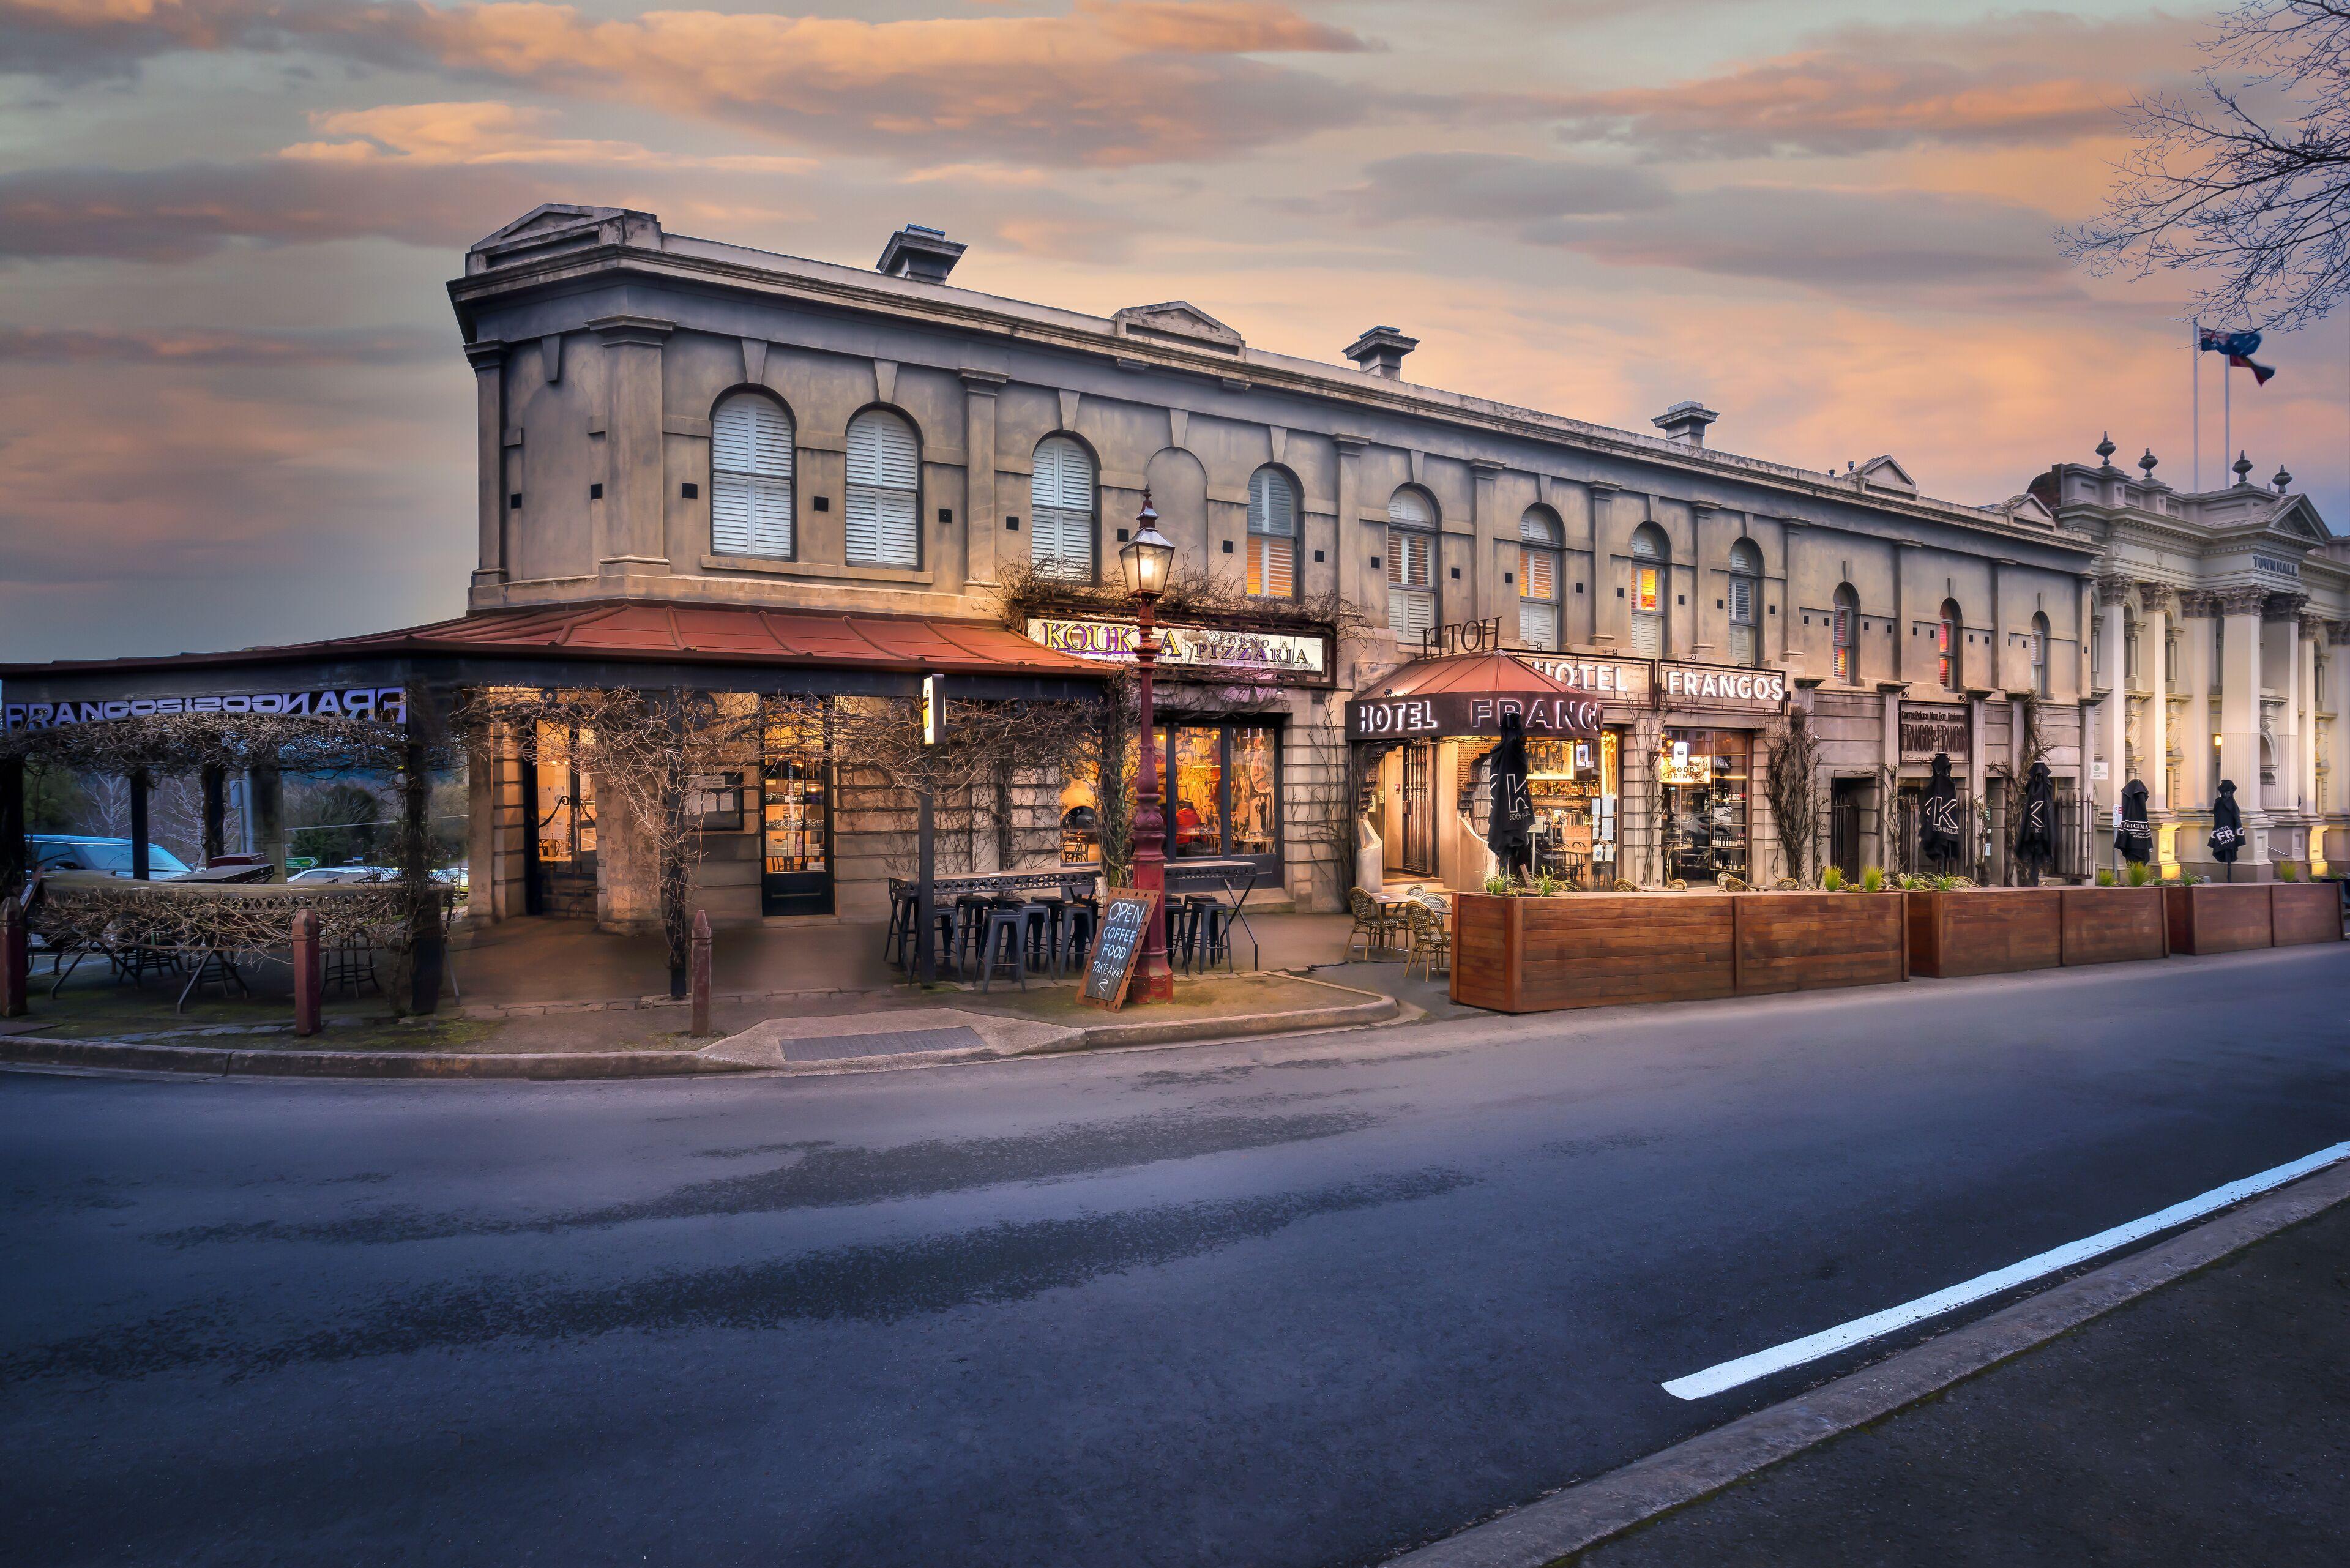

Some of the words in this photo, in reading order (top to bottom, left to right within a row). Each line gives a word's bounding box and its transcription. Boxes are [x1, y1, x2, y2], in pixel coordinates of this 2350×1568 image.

[2253, 555, 2276, 572] TOWN
[2277, 561, 2297, 577] HALL
[1042, 622, 1182, 657] KOUKA
[1194, 643, 1311, 664] PIZZARIA
[1666, 671, 1783, 701] FRANGOS
[1359, 700, 1438, 733] HOTEL
[1933, 796, 1959, 829] K
[1933, 826, 1959, 835] KOUKLA
[1109, 902, 1145, 925] OPEN
[1103, 926, 1137, 943] COFFEE
[1102, 943, 1127, 960] FOOD
[1092, 961, 1125, 978] TAKEAWAY
